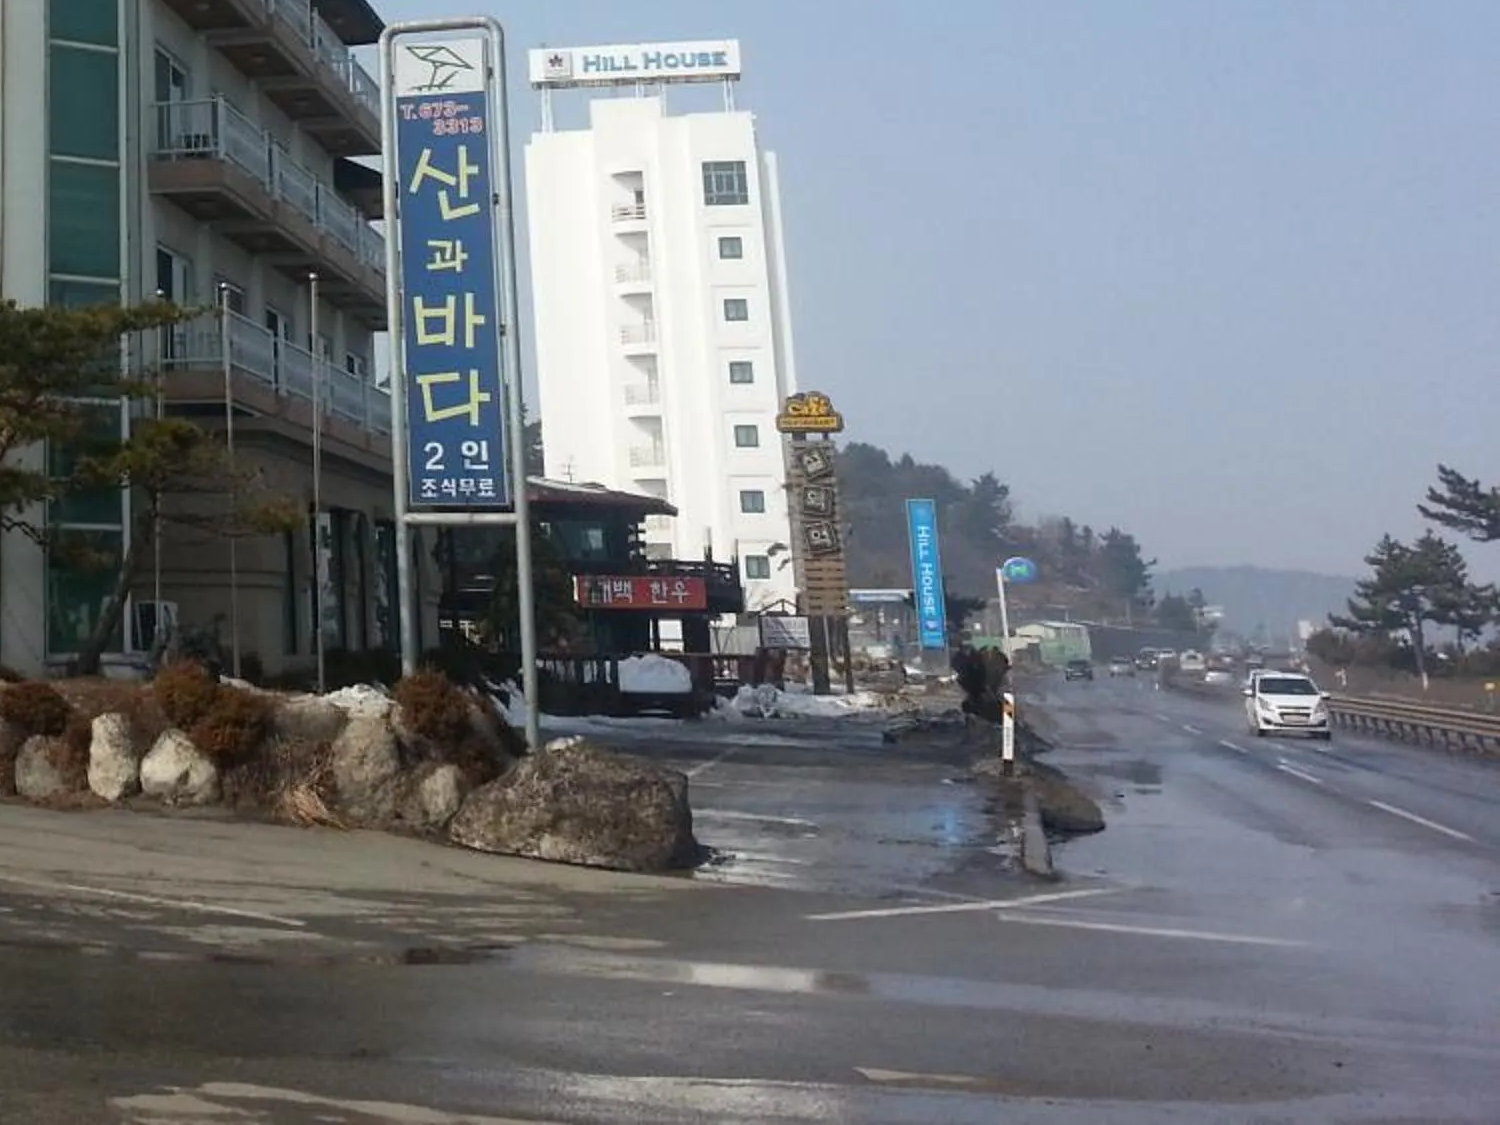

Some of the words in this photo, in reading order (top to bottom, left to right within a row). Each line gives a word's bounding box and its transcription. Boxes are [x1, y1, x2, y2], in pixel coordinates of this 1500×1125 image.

[583, 55, 638, 73] HILL
[642, 50, 728, 70] HOUSE
[420, 478, 496, 498] 조식무료
[649, 580, 691, 604] 한우
